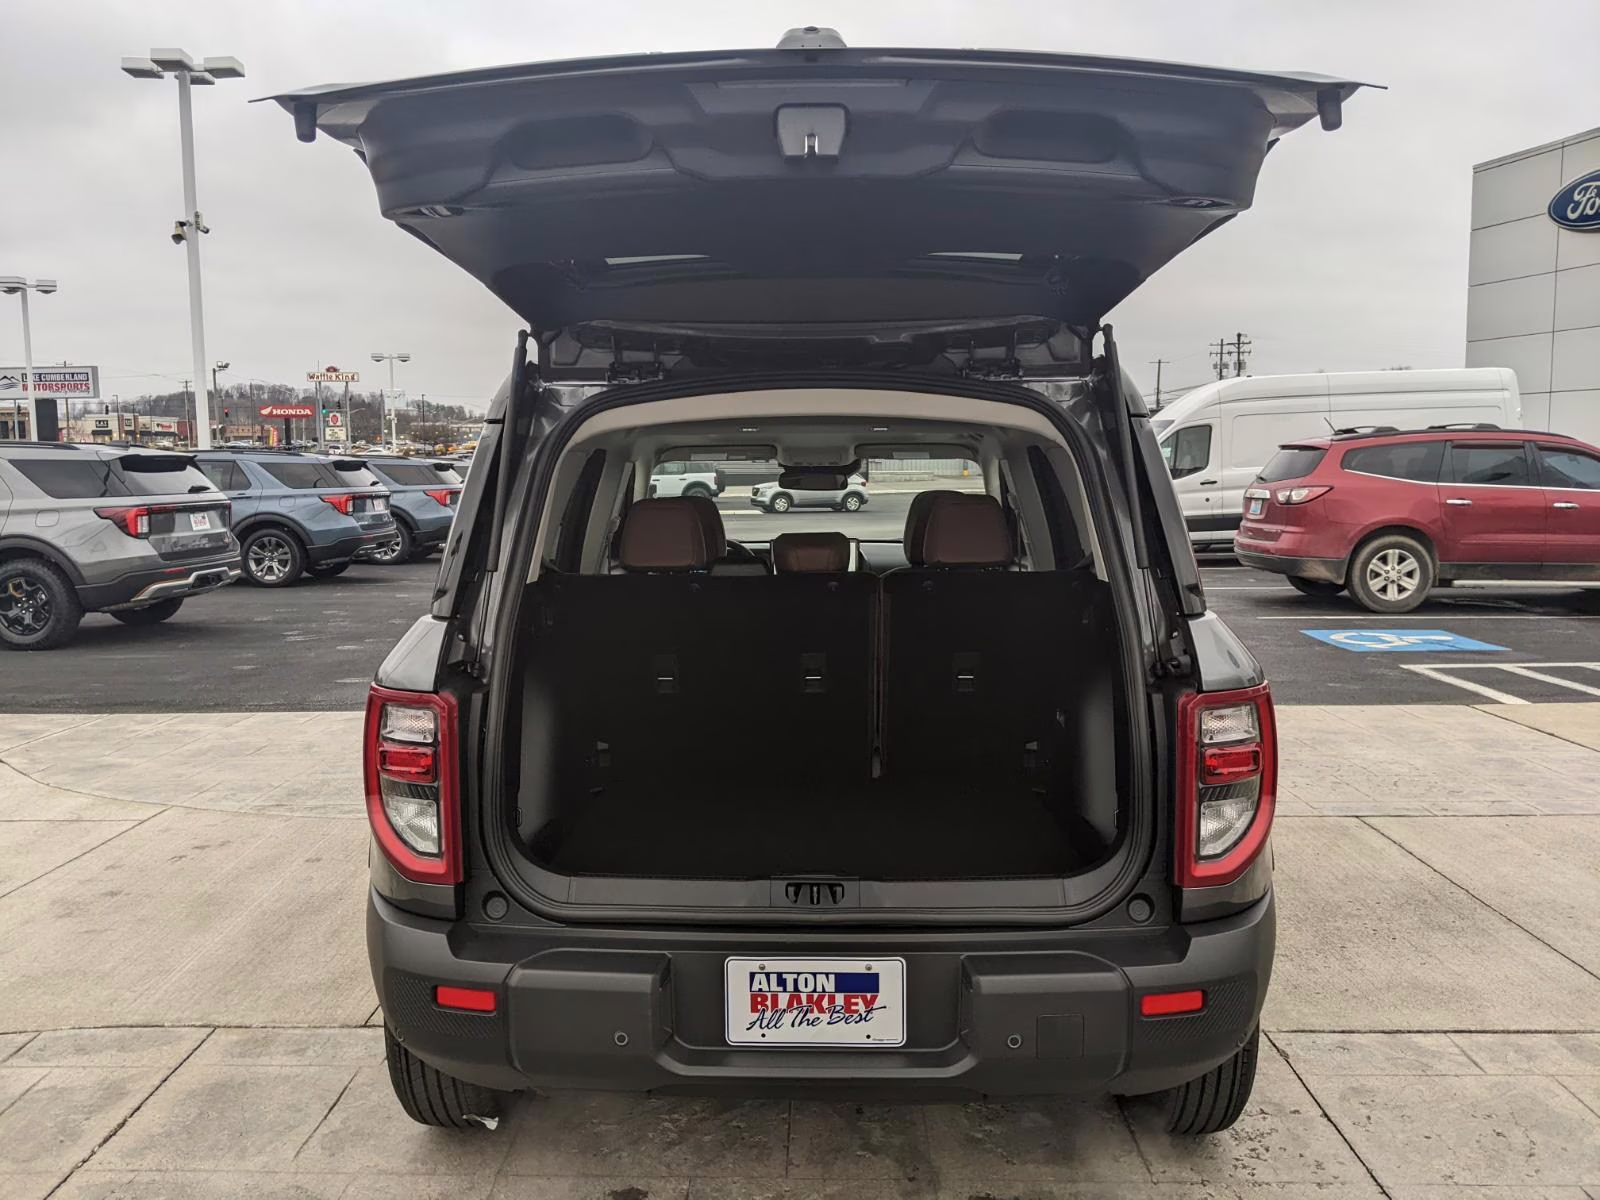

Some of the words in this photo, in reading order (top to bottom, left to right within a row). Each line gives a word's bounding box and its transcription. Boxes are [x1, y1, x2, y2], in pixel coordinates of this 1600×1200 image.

[1566, 181, 1600, 220] Fo
[23, 373, 40, 382] LKE
[41, 373, 88, 382] CUMBERLAND
[308, 373, 333, 381] Waffle
[334, 373, 356, 381] King
[751, 973, 836, 992] ALTON
[750, 993, 879, 1014] BLAKLEY
[746, 1007, 787, 1031] All
[789, 1005, 824, 1028] The
[826, 1005, 887, 1025] Best
